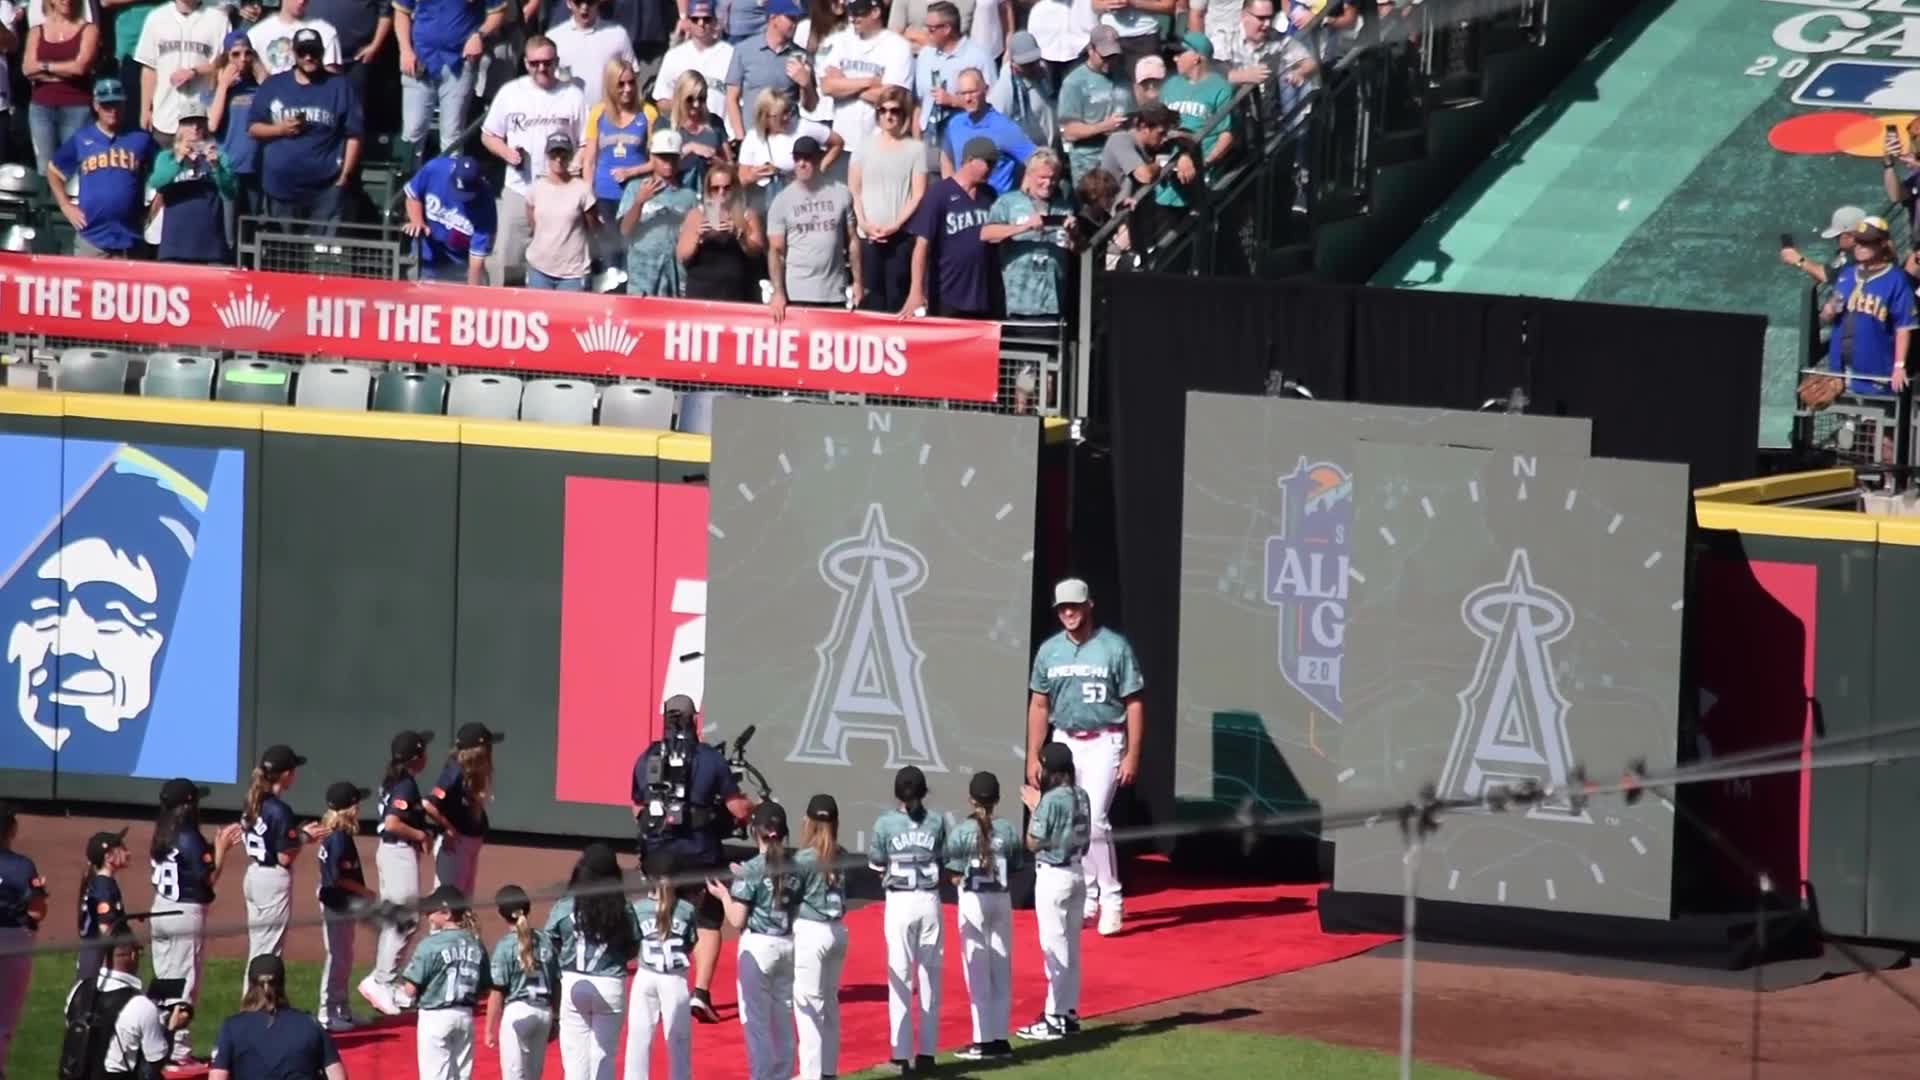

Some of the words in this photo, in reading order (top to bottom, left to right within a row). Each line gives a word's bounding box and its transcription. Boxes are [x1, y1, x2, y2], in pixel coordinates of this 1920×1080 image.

[14, 275, 83, 319] THE
[91, 280, 191, 327] BUDS
[305, 296, 367, 339] HIT
[374, 300, 442, 345] THE
[450, 305, 550, 353] BUDS
[664, 321, 724, 364] HIT
[731, 325, 800, 370] THE
[808, 331, 908, 377] BUDS
[868, 411, 891, 432] N
[1512, 455, 1537, 477] N
[1081, 682, 1107, 703] 53
